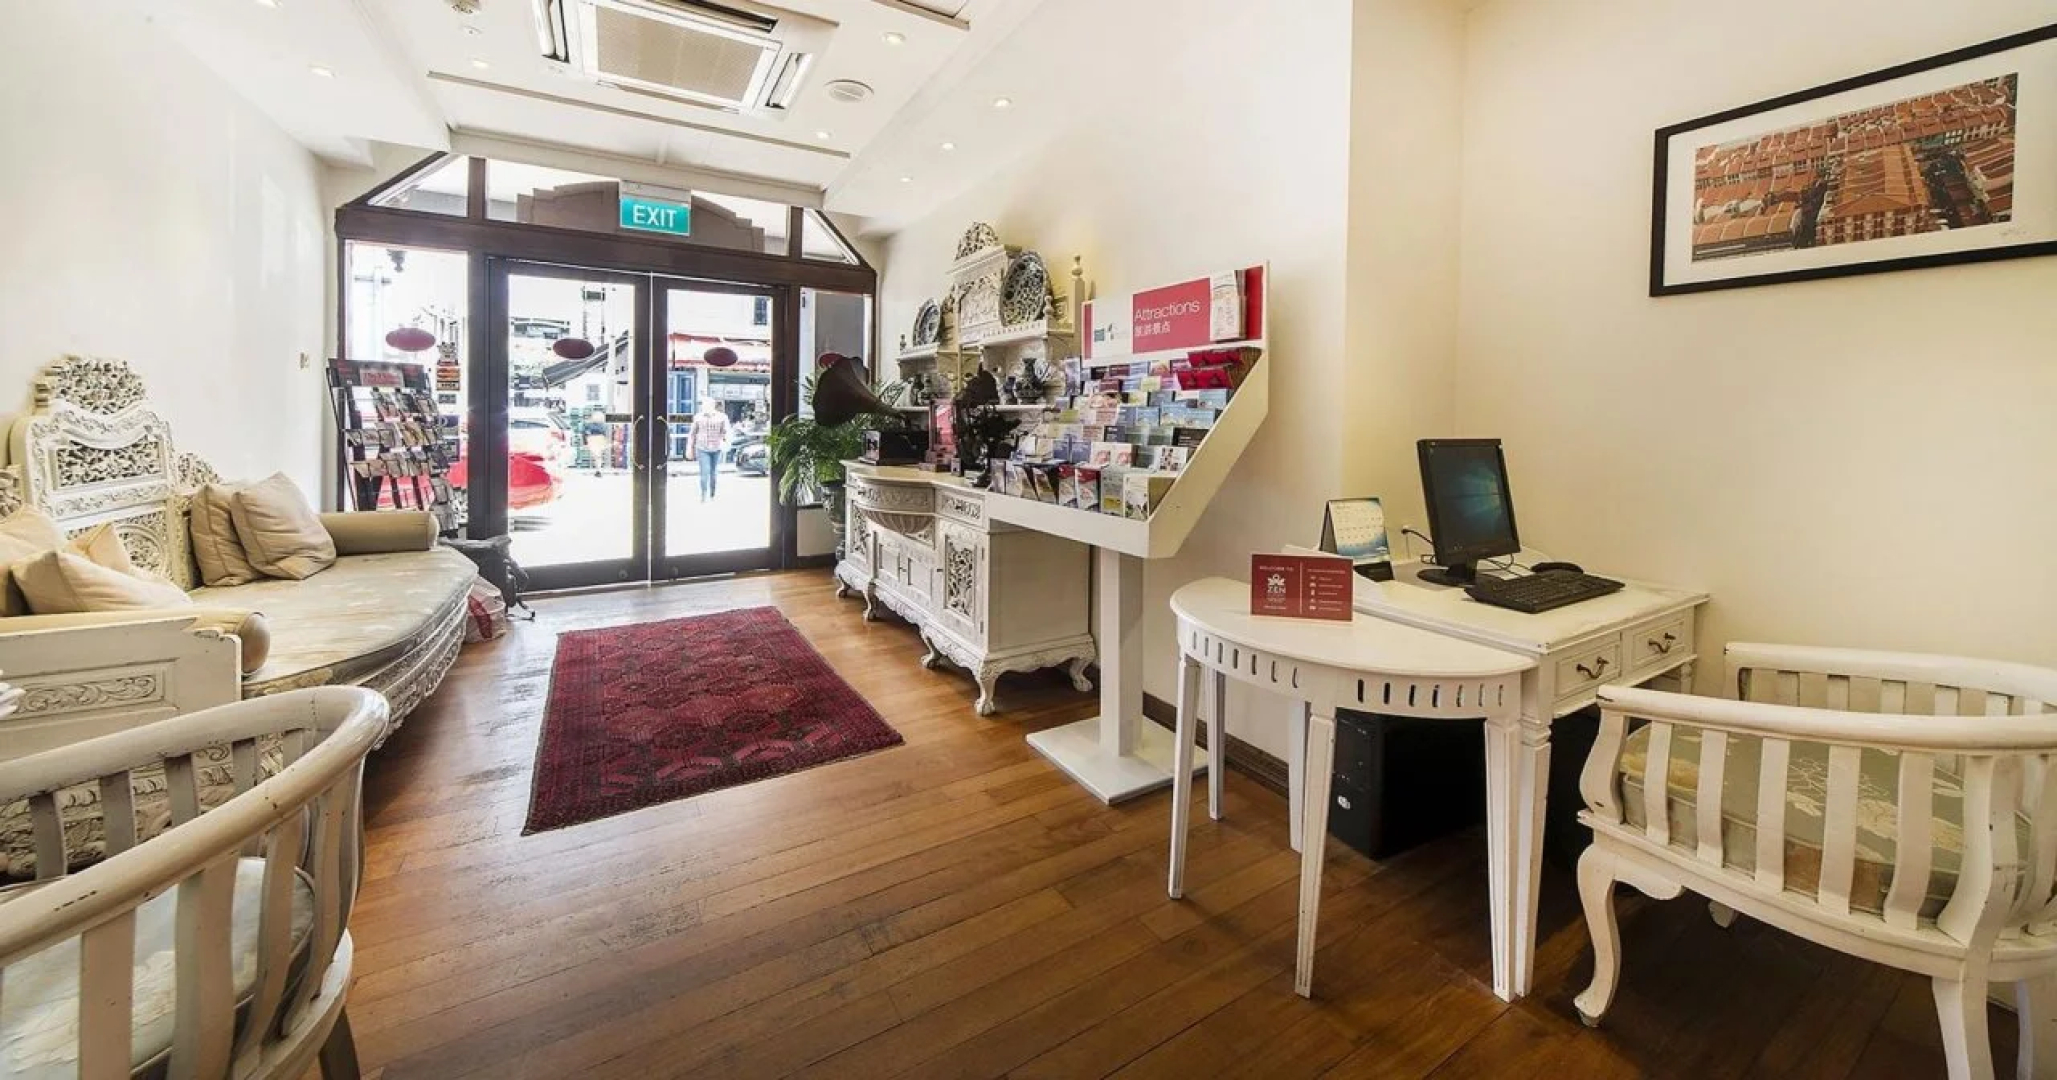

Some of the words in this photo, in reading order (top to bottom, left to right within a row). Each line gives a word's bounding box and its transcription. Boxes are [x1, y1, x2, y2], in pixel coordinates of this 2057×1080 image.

[632, 204, 677, 228] EXIT
[1134, 300, 1201, 321] Attractions
[1266, 586, 1286, 594] ZEN
